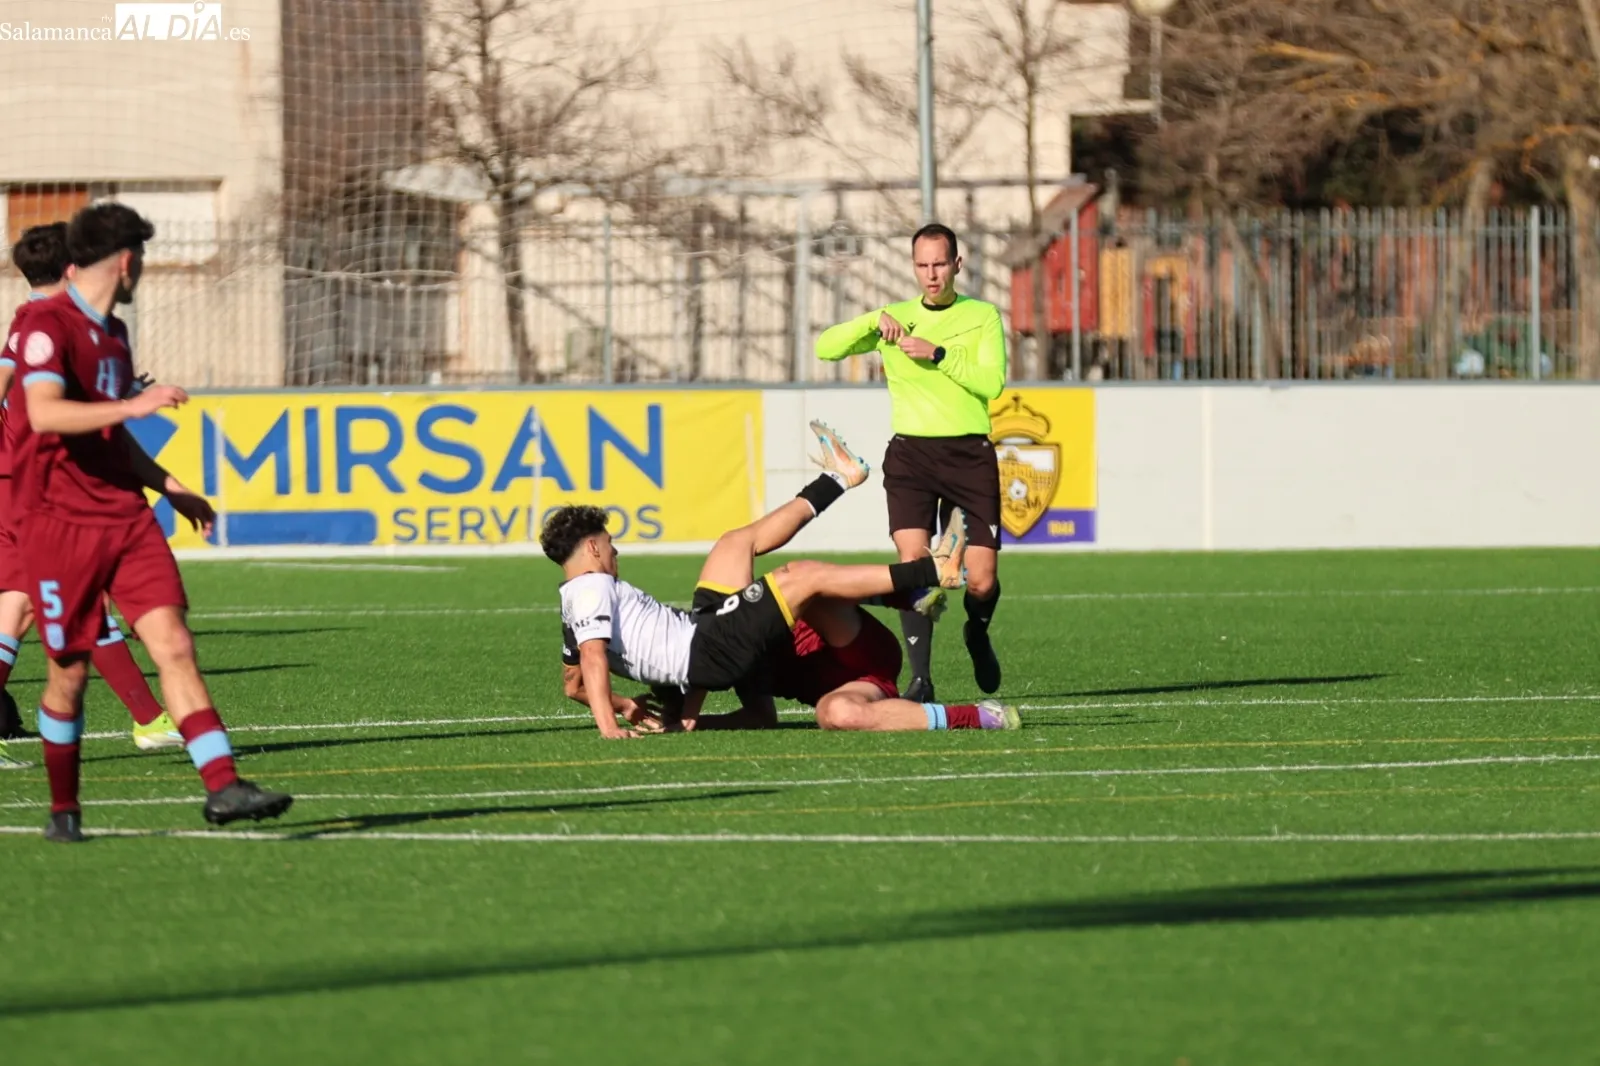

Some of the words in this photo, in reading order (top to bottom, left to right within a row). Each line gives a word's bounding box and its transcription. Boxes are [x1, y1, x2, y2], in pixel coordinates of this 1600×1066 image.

[202, 403, 664, 496] MIRSAN
[392, 504, 664, 543] SERVIOS
[39, 580, 64, 619] 5
